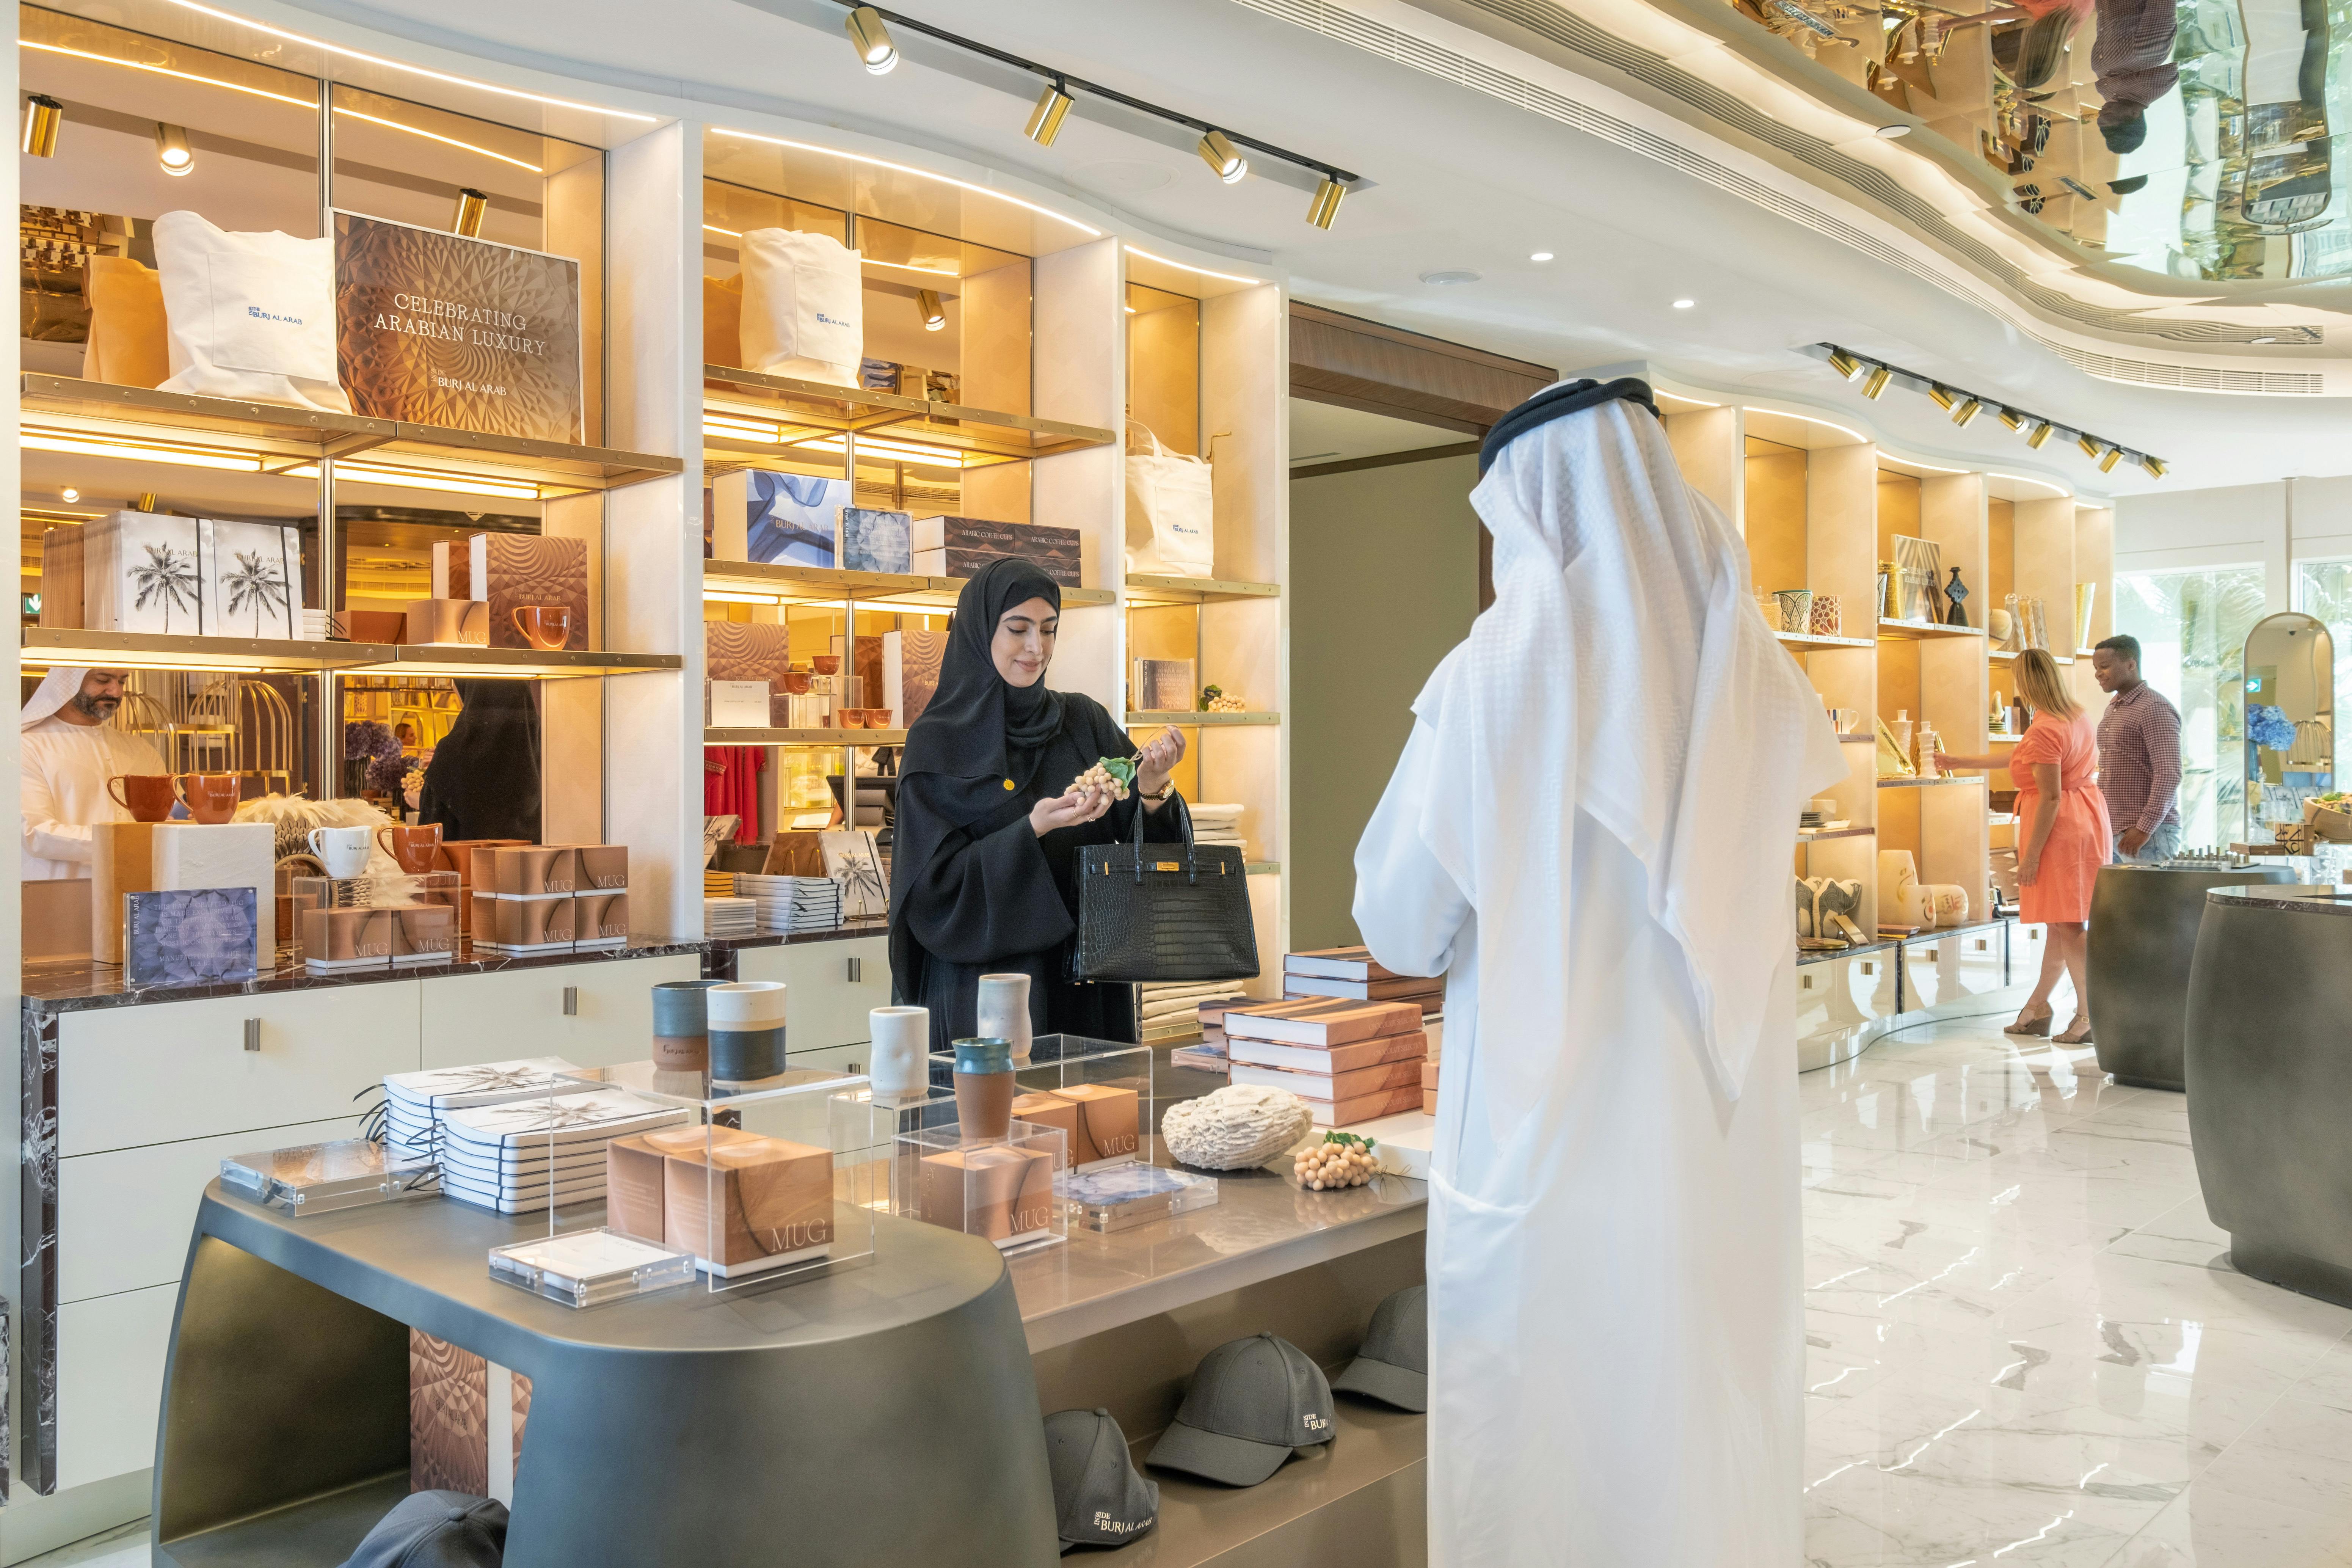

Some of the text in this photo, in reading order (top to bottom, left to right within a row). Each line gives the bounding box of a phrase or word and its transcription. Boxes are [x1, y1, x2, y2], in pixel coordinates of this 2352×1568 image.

[253, 311, 270, 320] BURJ
[283, 316, 302, 325] ARAB
[394, 293, 527, 330] CELEBRATING
[374, 313, 546, 356] ARABIAN LUXURY
[438, 377, 507, 396] BURJ AL ARAB
[776, 520, 795, 531] BURJ
[797, 522, 806, 531] AL
[1905, 576, 1921, 584] ARABIAN
[458, 630, 486, 644] MUG
[544, 879, 572, 893] MUG
[598, 874, 624, 888] MUG
[544, 929, 572, 943] MUG
[599, 924, 626, 937] MUG
[356, 942, 388, 957] MUG
[419, 938, 449, 952] MUG
[160, 952, 215, 962] MANUFACTURED
[1369, 1016, 1419, 1031] CHOCOLATE SELECTION
[1374, 1046, 1402, 1057] CHOCOLATE
[1402, 1042, 1424, 1052] SELECTION
[1375, 1072, 1402, 1084] CHOCOLATE
[1375, 1098, 1402, 1110] CHOCOLATE
[1104, 1134, 1135, 1157] MUG
[1053, 1149, 1073, 1170] UG
[1011, 1207, 1048, 1234] MUG
[771, 1218, 827, 1252] MUG
[1101, 1517, 1153, 1535] BURJ AL ARAB
